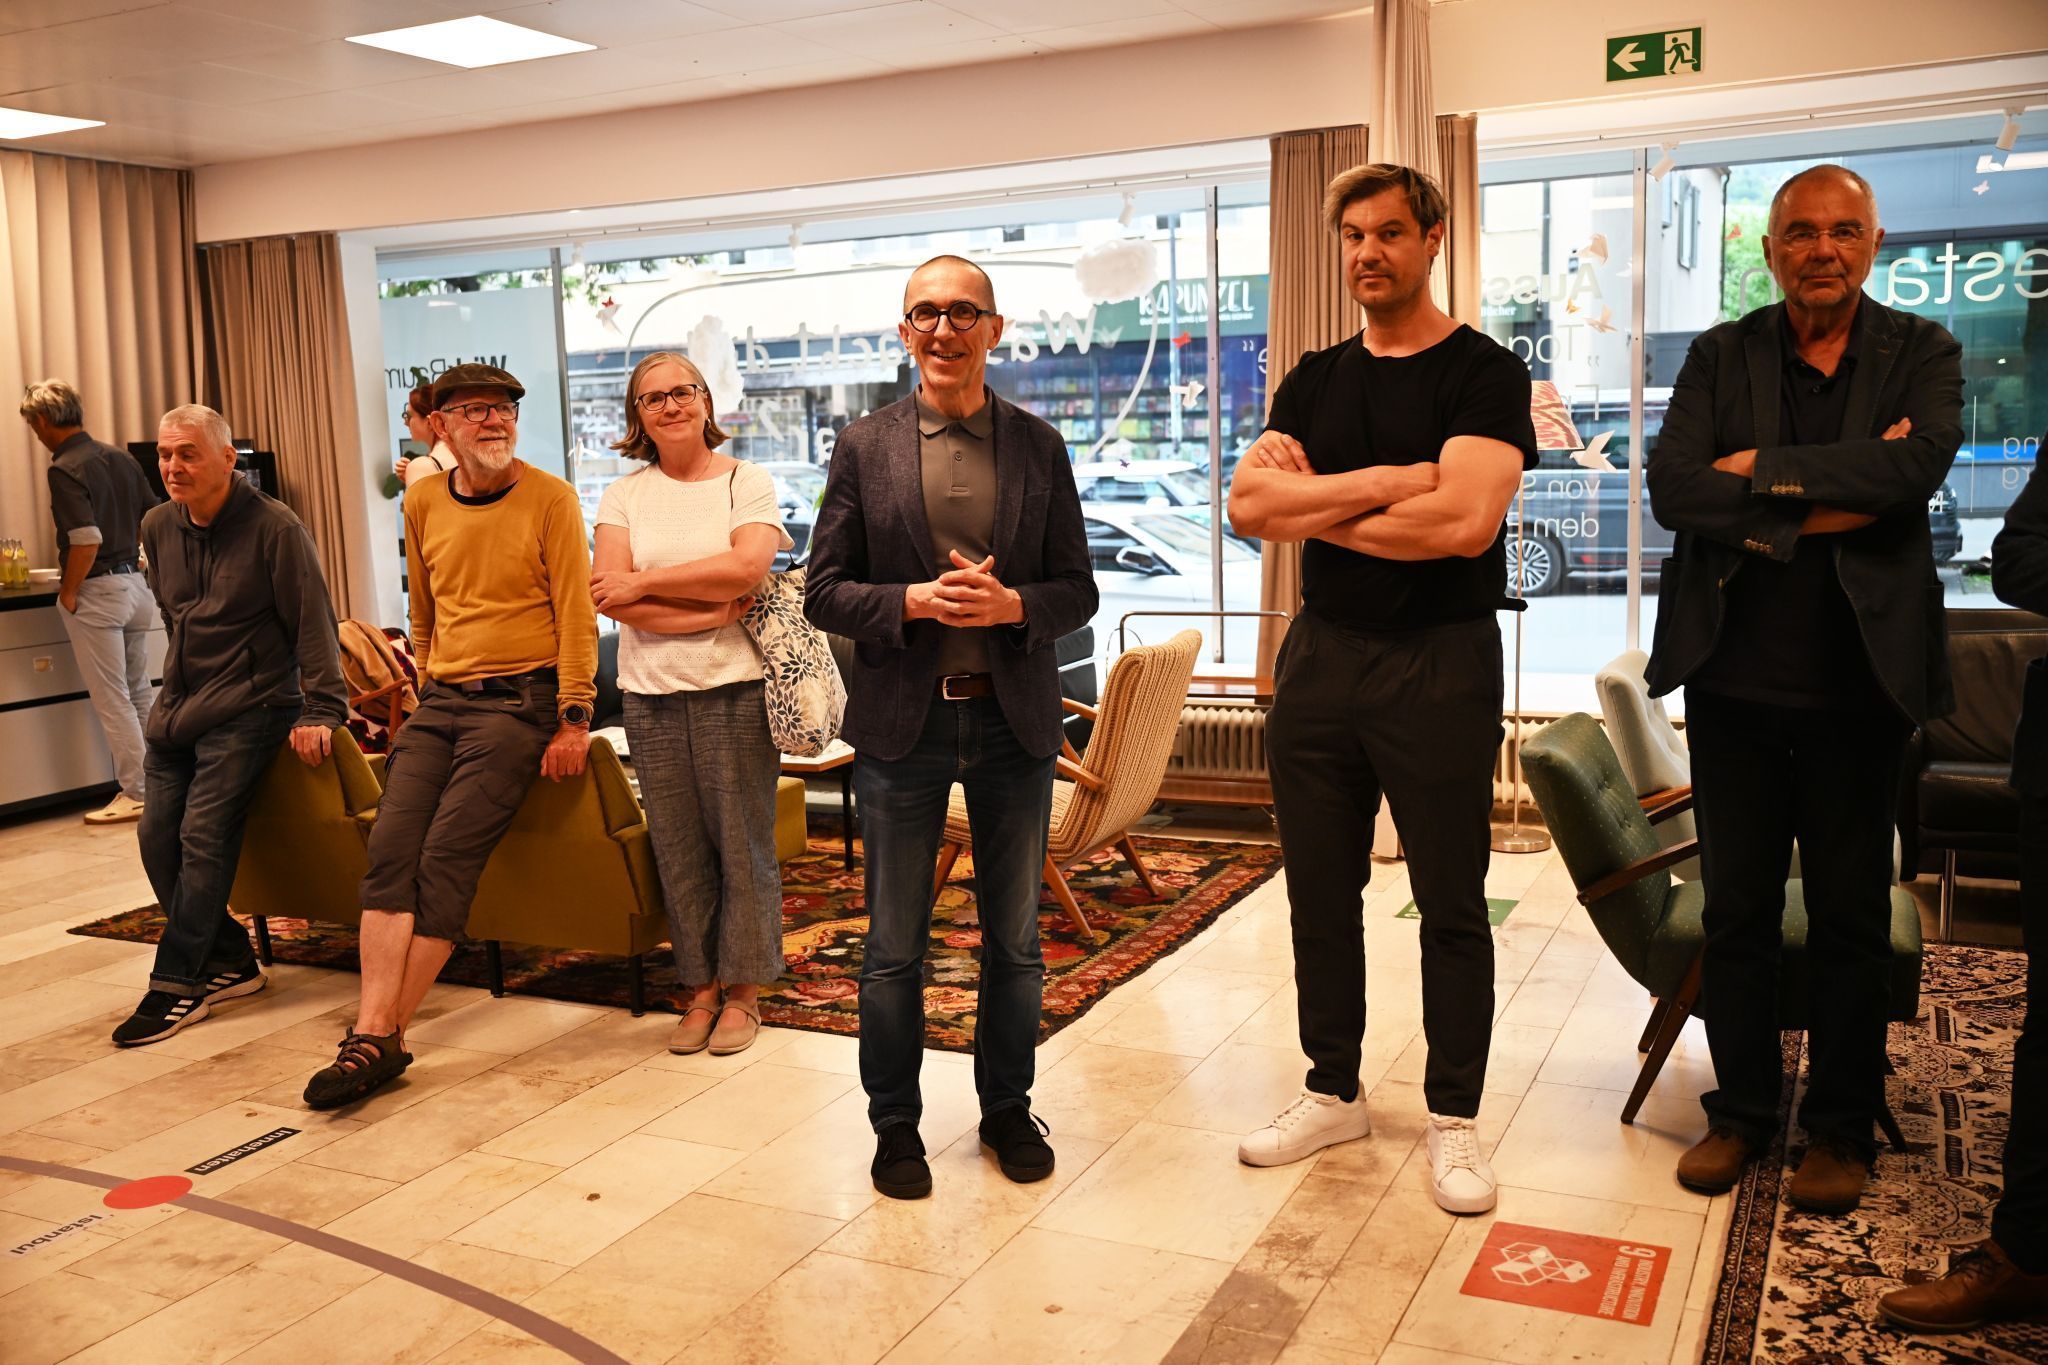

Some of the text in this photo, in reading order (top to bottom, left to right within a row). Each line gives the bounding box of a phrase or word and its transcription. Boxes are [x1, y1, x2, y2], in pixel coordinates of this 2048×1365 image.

[195, 1130, 293, 1173] Innehalten
[11, 1214, 103, 1255] Istanbul
[1618, 1245, 1657, 1258] 9
